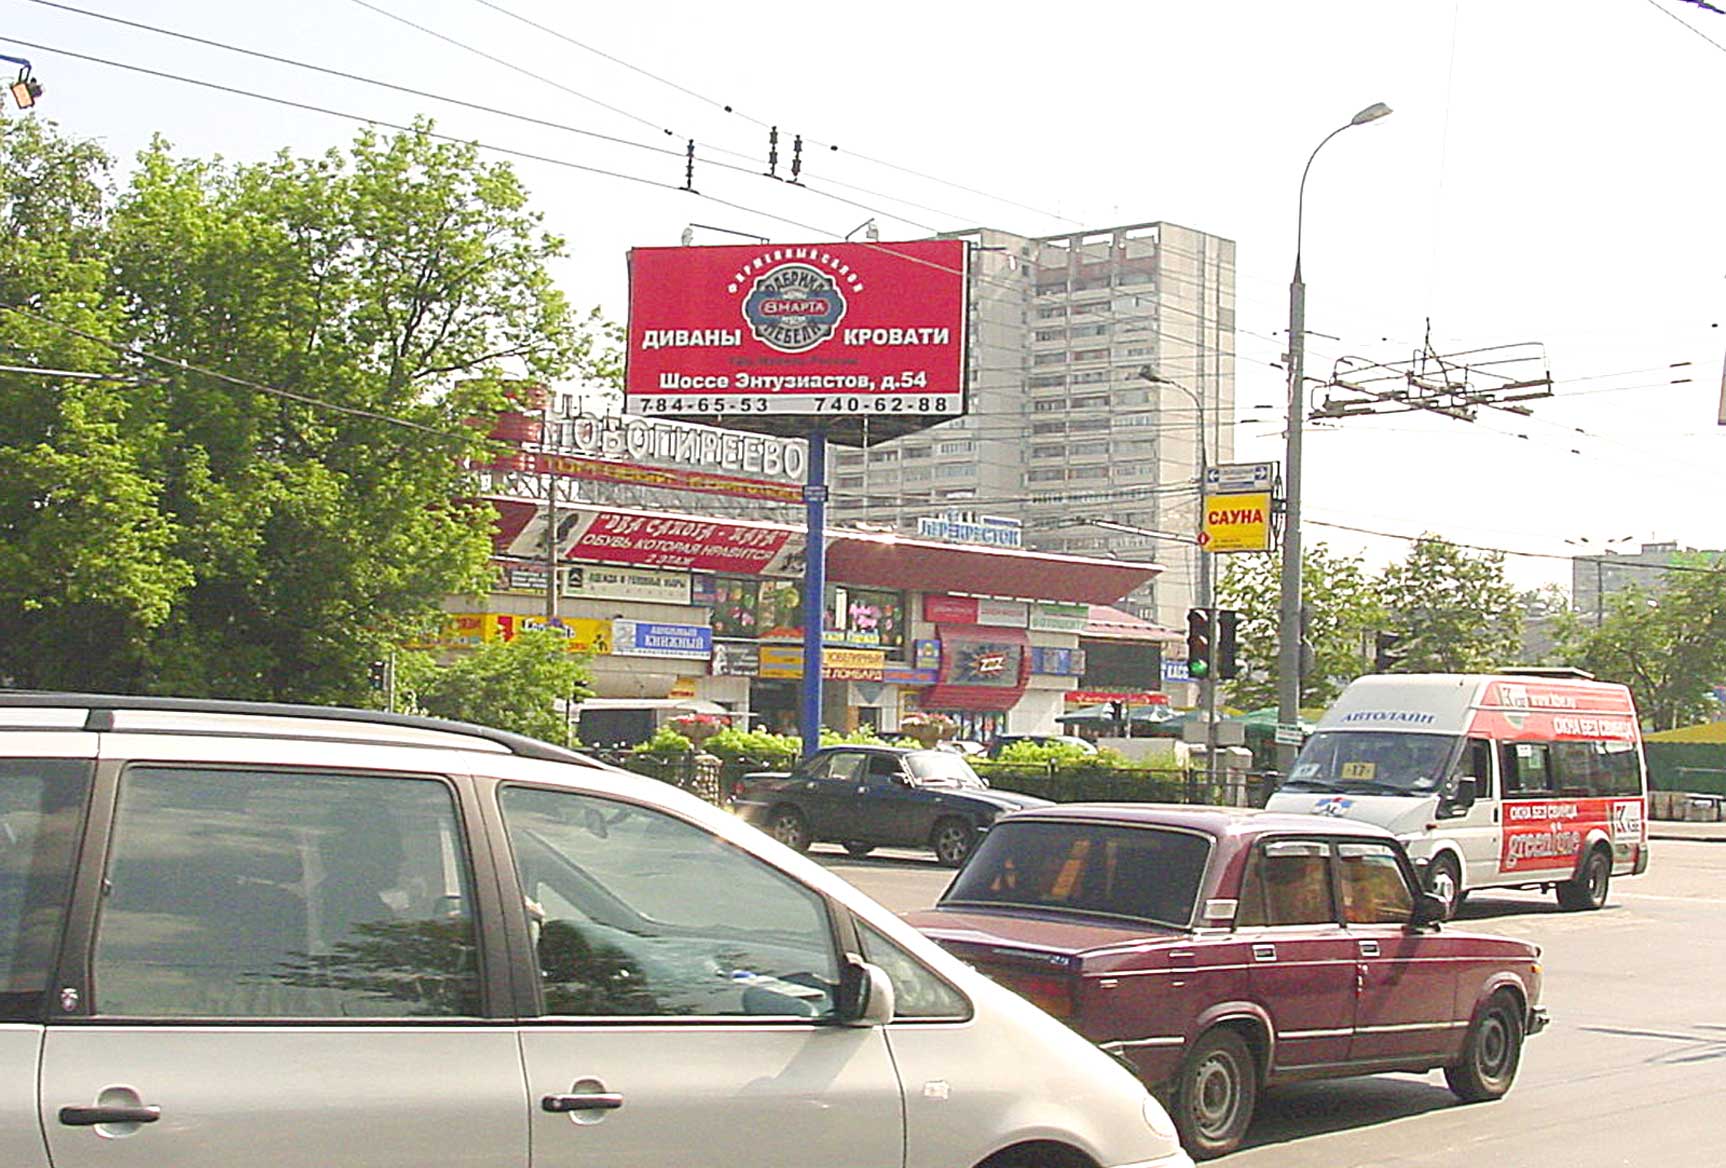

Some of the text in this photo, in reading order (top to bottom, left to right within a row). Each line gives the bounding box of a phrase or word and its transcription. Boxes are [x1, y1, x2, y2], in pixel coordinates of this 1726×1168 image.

[642, 328, 949, 349] ДИВАНЫ КРОВАТИ
[660, 371, 927, 391] Шоссе Энтузиастов, д.54
[814, 398, 947, 412] 740-62-88
[1208, 508, 1264, 525] САУНА
[920, 520, 1019, 546] ПЕРЕКРЕСТОК
[582, 533, 775, 560] ОБУВЬ КОТОРАЯ НРАВИТСЯ
[831, 669, 882, 680] ЛОМБАРД
[1342, 711, 1435, 724] АВТОЛАЙН
